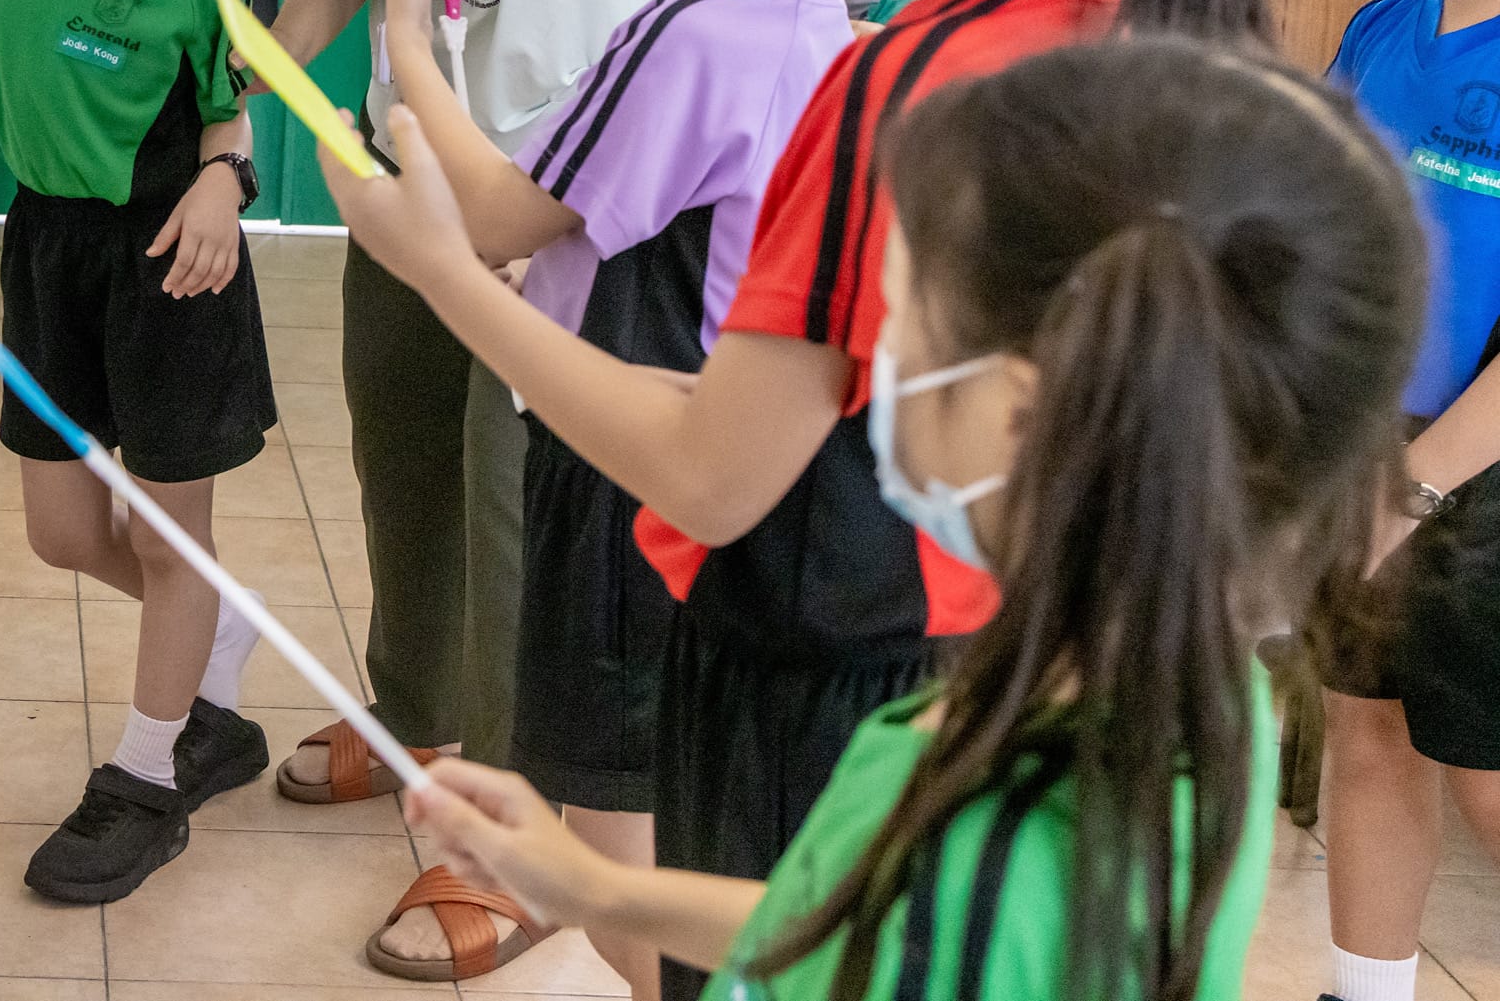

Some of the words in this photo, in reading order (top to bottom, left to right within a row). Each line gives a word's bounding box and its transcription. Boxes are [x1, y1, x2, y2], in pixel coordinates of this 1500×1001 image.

[66, 15, 141, 52] Emerald
[62, 36, 89, 52] Jodie
[93, 46, 119, 65] Kong
[1416, 154, 1461, 177] Katerina
